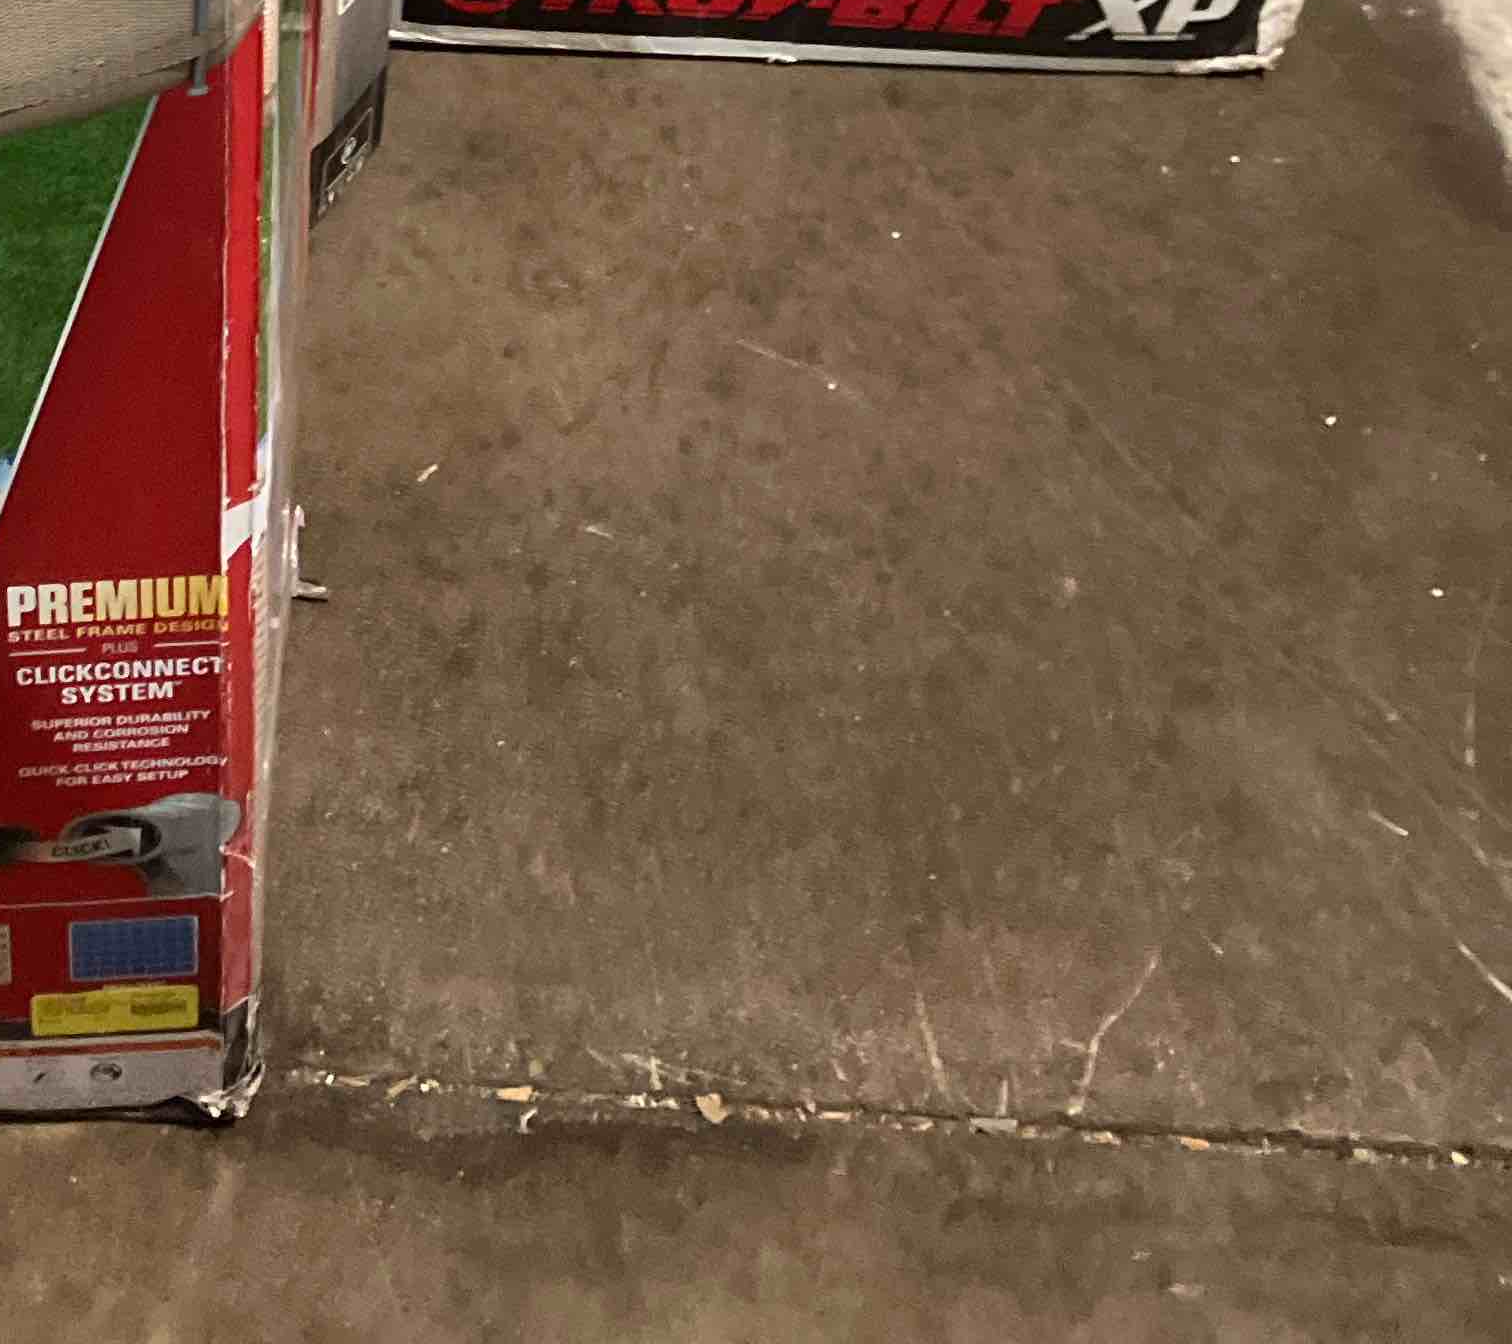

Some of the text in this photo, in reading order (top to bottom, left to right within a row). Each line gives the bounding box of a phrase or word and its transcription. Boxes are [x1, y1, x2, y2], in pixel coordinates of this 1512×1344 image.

[7, 574, 230, 628] PREMIUM
[7, 628, 70, 644] STEEL
[75, 622, 148, 639] FRAME
[15, 655, 224, 687] CLICKCONNECT
[31, 709, 212, 731] SUPERIOR DURABILITY
[53, 724, 190, 743] AND CORROSION
[71, 736, 172, 753] RESISTANCE
[55, 768, 190, 788] FOR EASY SETUP
